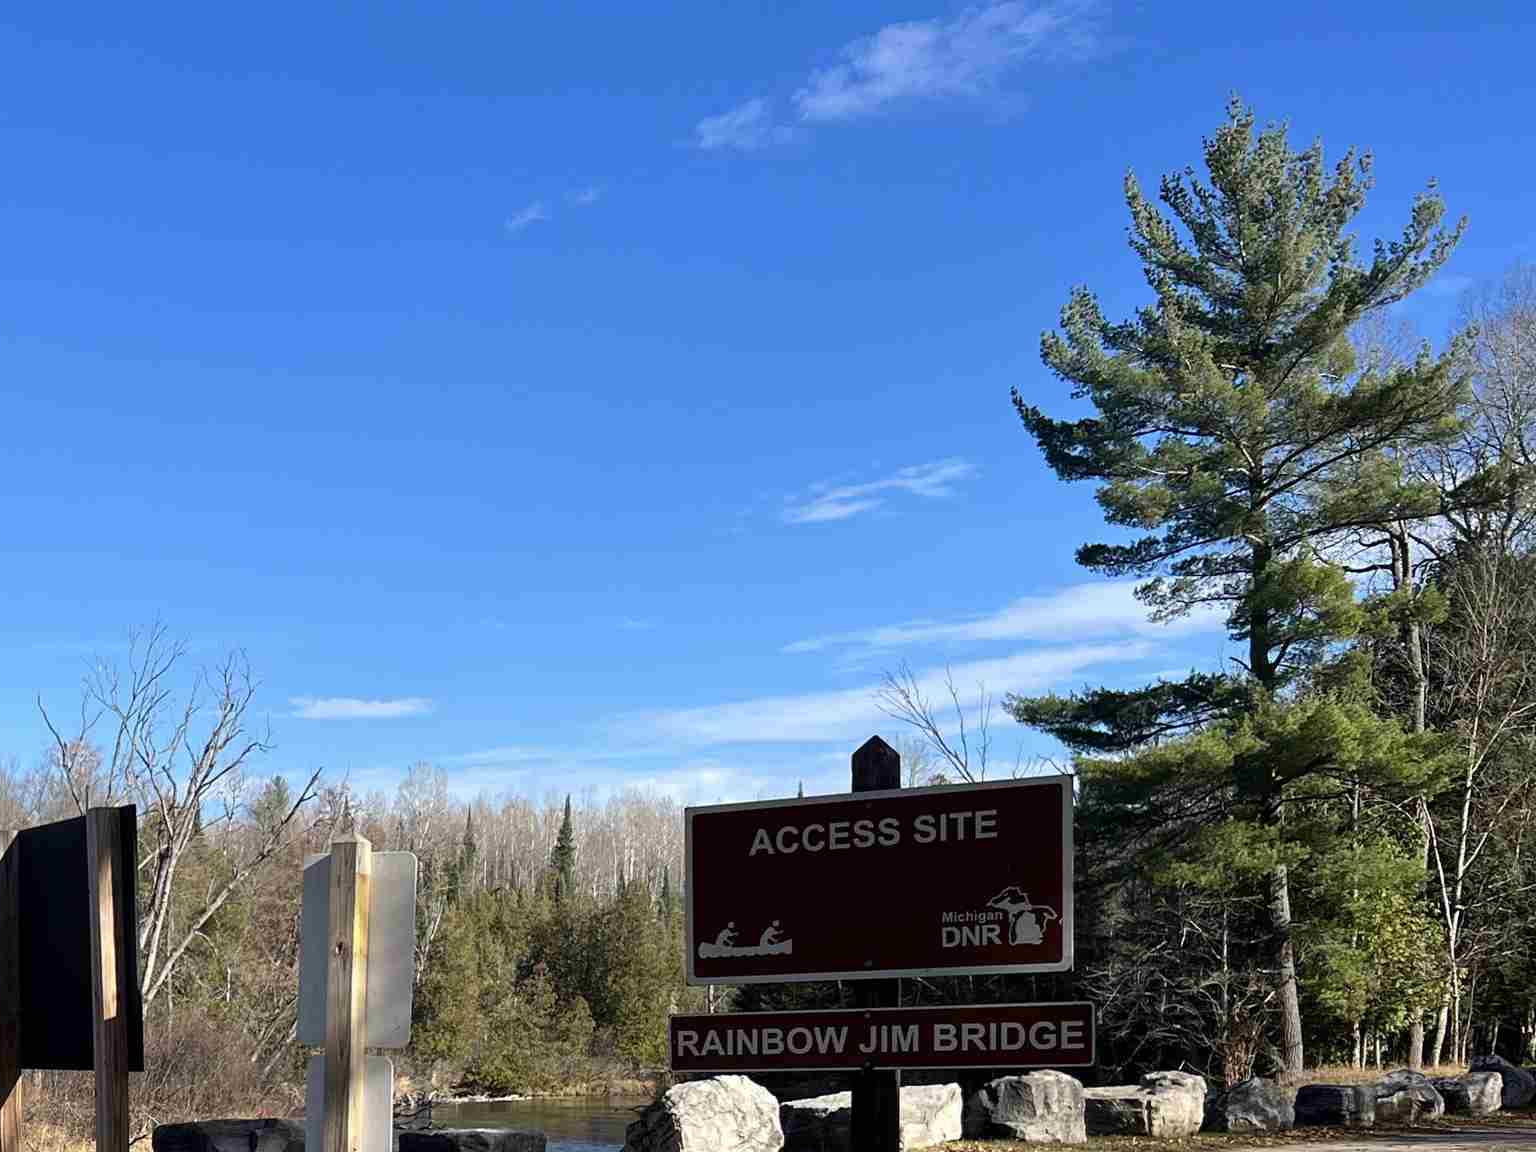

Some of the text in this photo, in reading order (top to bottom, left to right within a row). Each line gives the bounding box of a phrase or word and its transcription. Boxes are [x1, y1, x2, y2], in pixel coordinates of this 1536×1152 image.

[749, 809, 999, 856] ACCESS SITE
[941, 909, 1004, 925] Michigan
[941, 923, 1002, 948] DNR
[677, 1021, 1085, 1056] RAINBOW JIM BRIDGE
